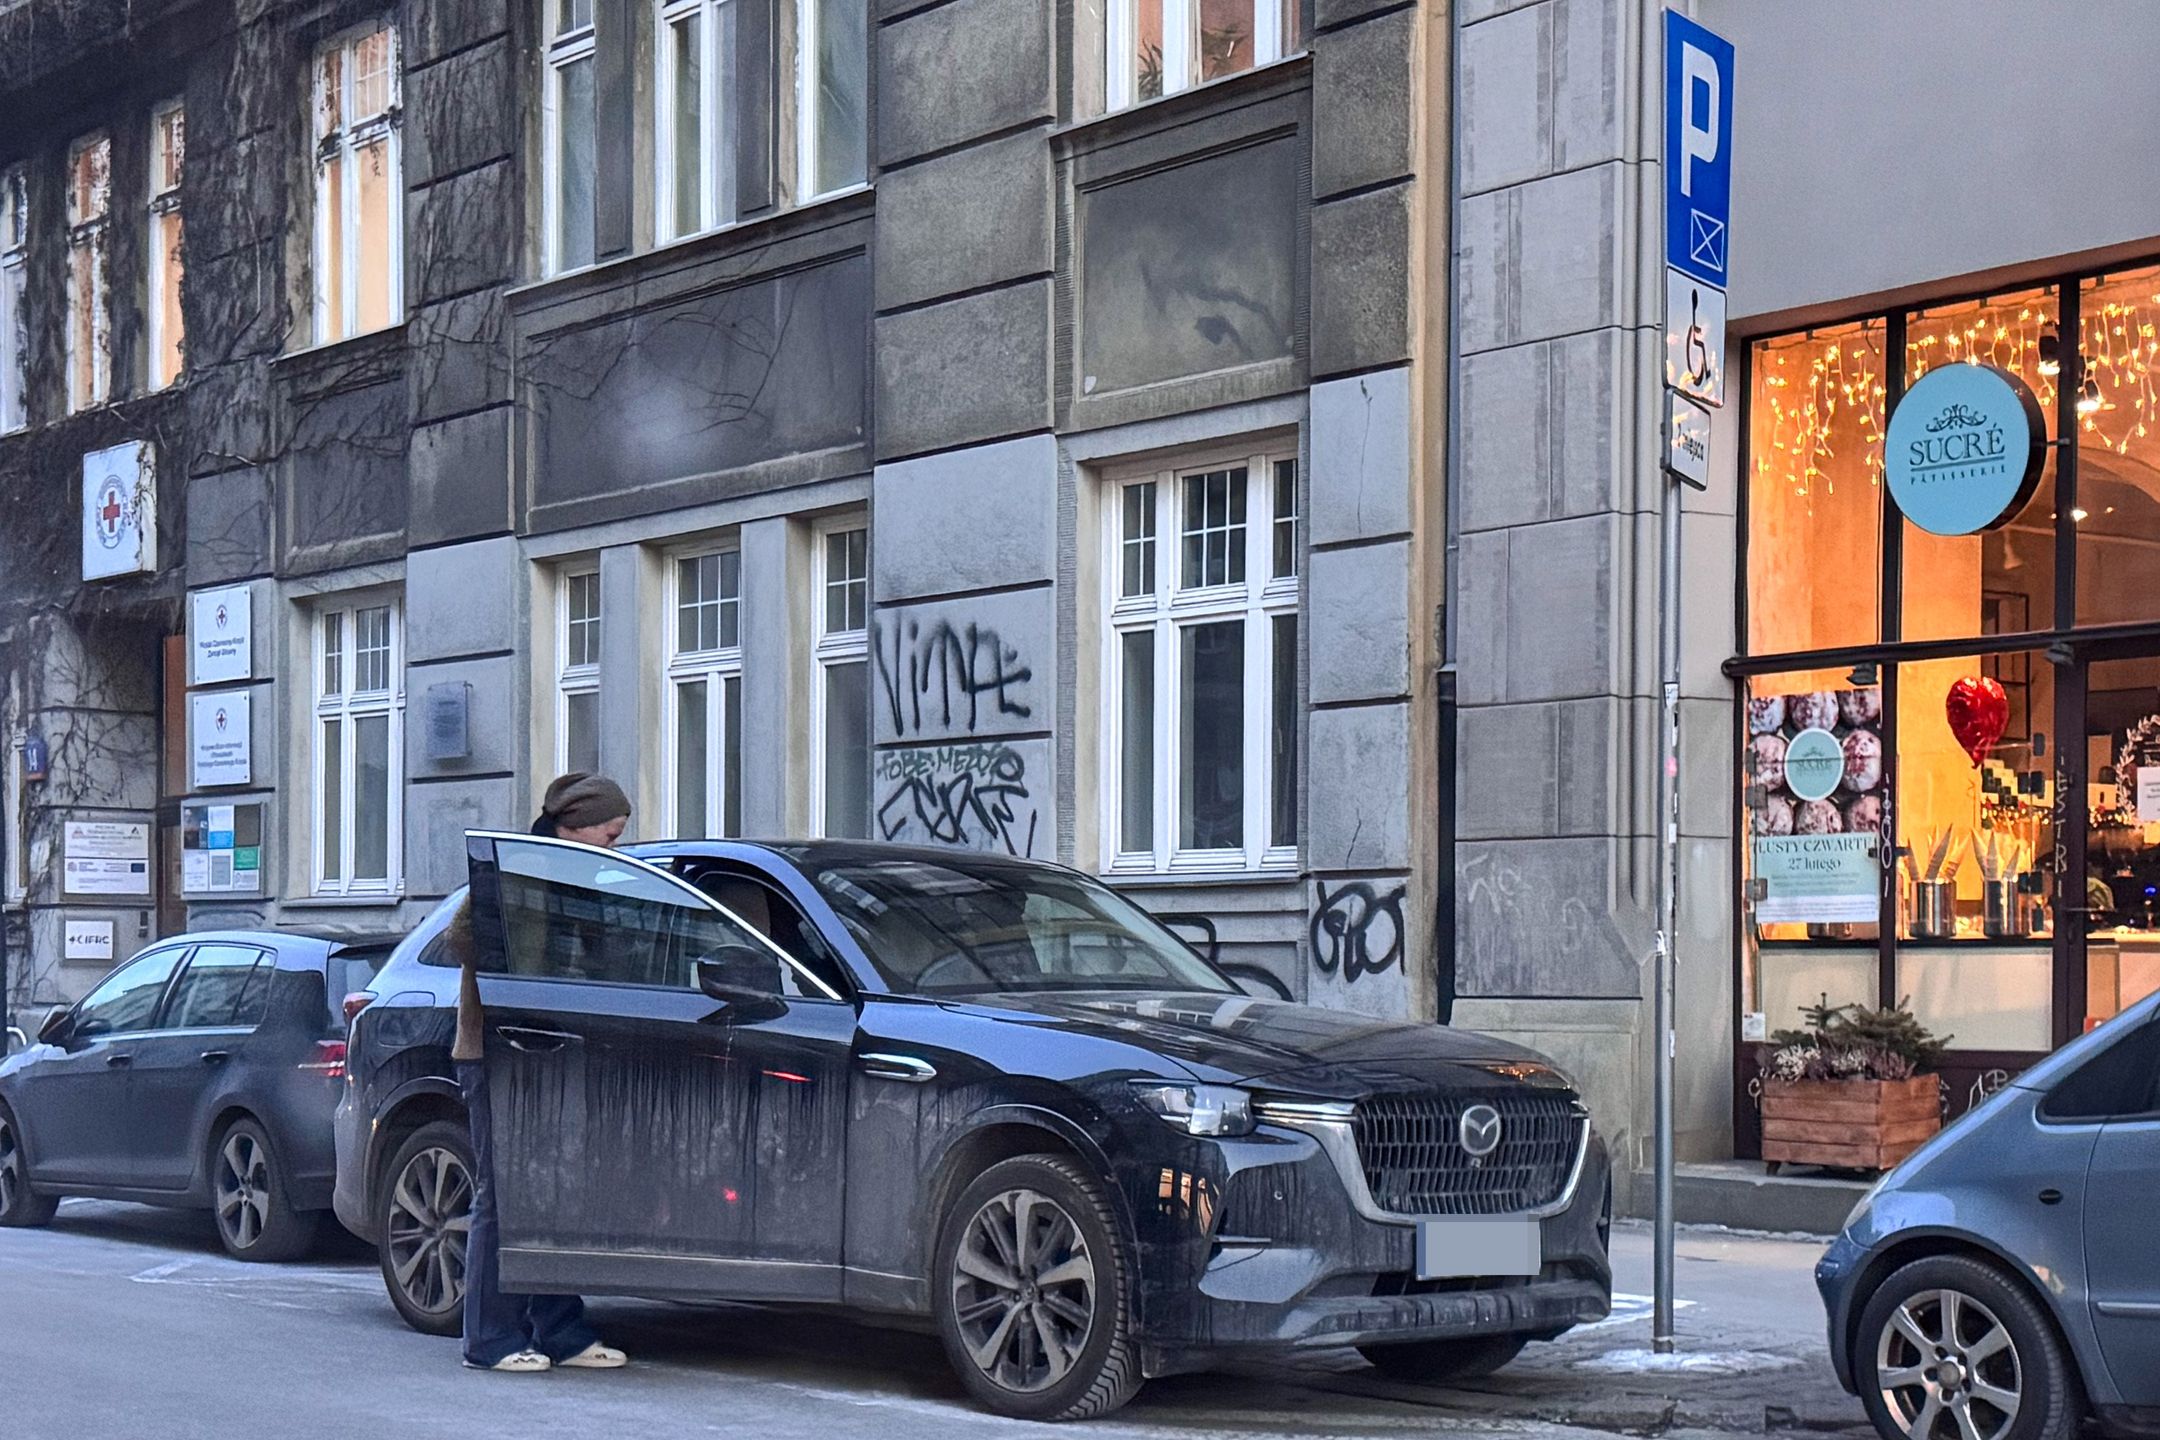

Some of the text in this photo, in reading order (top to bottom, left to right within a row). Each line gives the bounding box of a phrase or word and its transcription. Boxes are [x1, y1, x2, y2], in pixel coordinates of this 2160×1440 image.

[1681, 40, 1720, 198] P
[1909, 422, 2006, 466] SUCRÉ
[1788, 857, 1841, 873] 27 lutego
